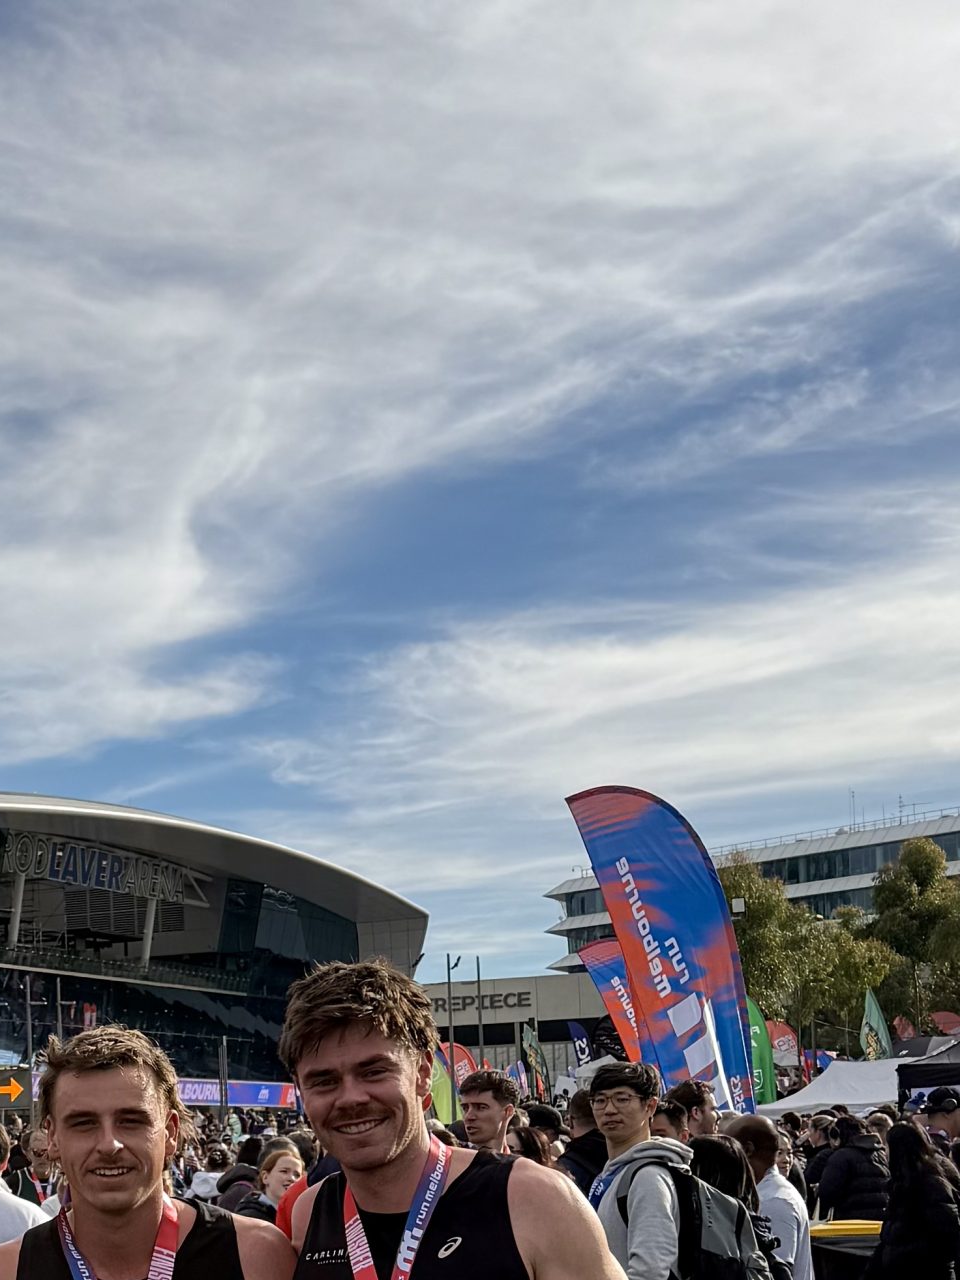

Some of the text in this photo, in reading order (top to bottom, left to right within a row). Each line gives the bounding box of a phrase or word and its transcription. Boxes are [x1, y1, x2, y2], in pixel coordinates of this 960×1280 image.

[1, 830, 185, 902] ROD LAVER ARENA
[344, 1214, 375, 1274] FINISHER
[416, 1202, 431, 1226] run
